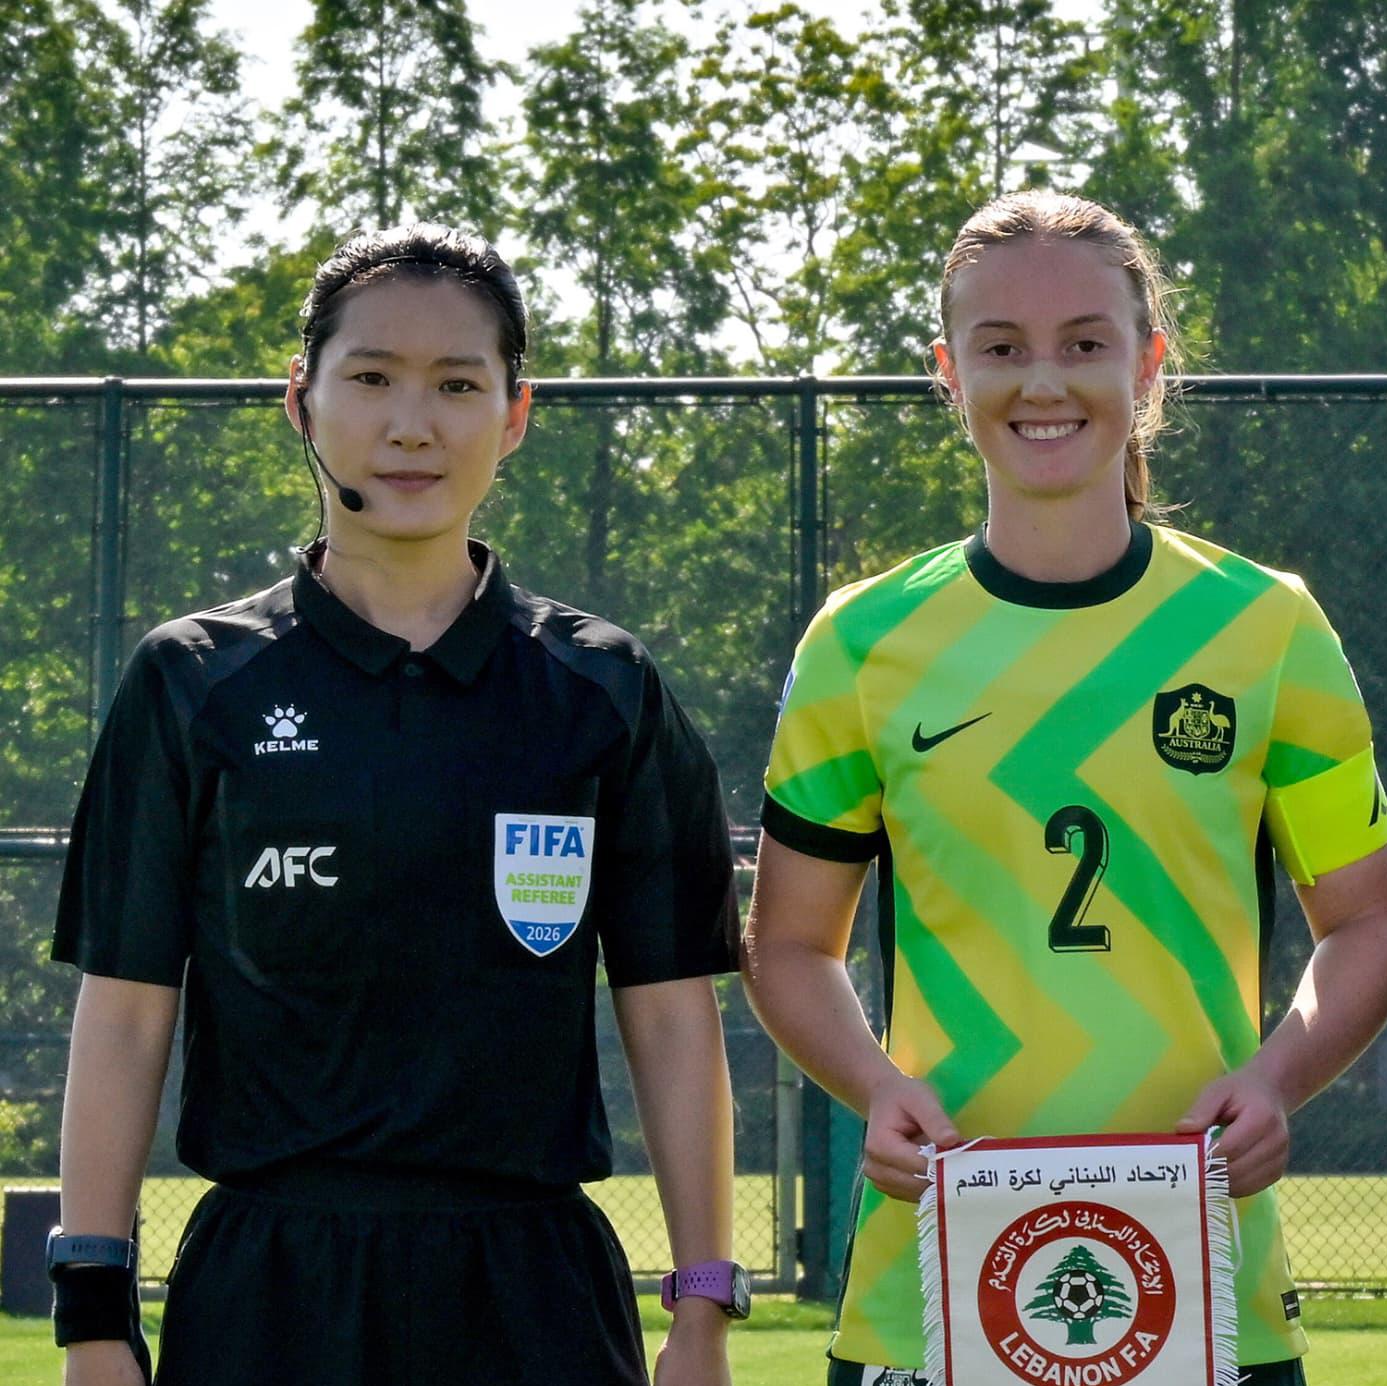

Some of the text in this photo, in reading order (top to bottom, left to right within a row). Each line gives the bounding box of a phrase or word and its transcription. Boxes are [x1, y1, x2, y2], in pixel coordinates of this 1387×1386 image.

[254, 739, 319, 755] KELME
[1169, 738, 1222, 752] AUSTRALIA
[505, 824, 585, 858] FIFA
[244, 846, 339, 888] AFC
[1044, 805, 1111, 953] 2
[505, 872, 584, 889] ASSISTANT
[511, 888, 577, 905] REFEREE
[526, 926, 561, 942] 2026
[956, 1170, 998, 1196] القدم
[1009, 1168, 1042, 1191] لكرة
[1049, 1166, 1116, 1195] اللبناني
[1119, 1331, 1160, 1368] F.A
